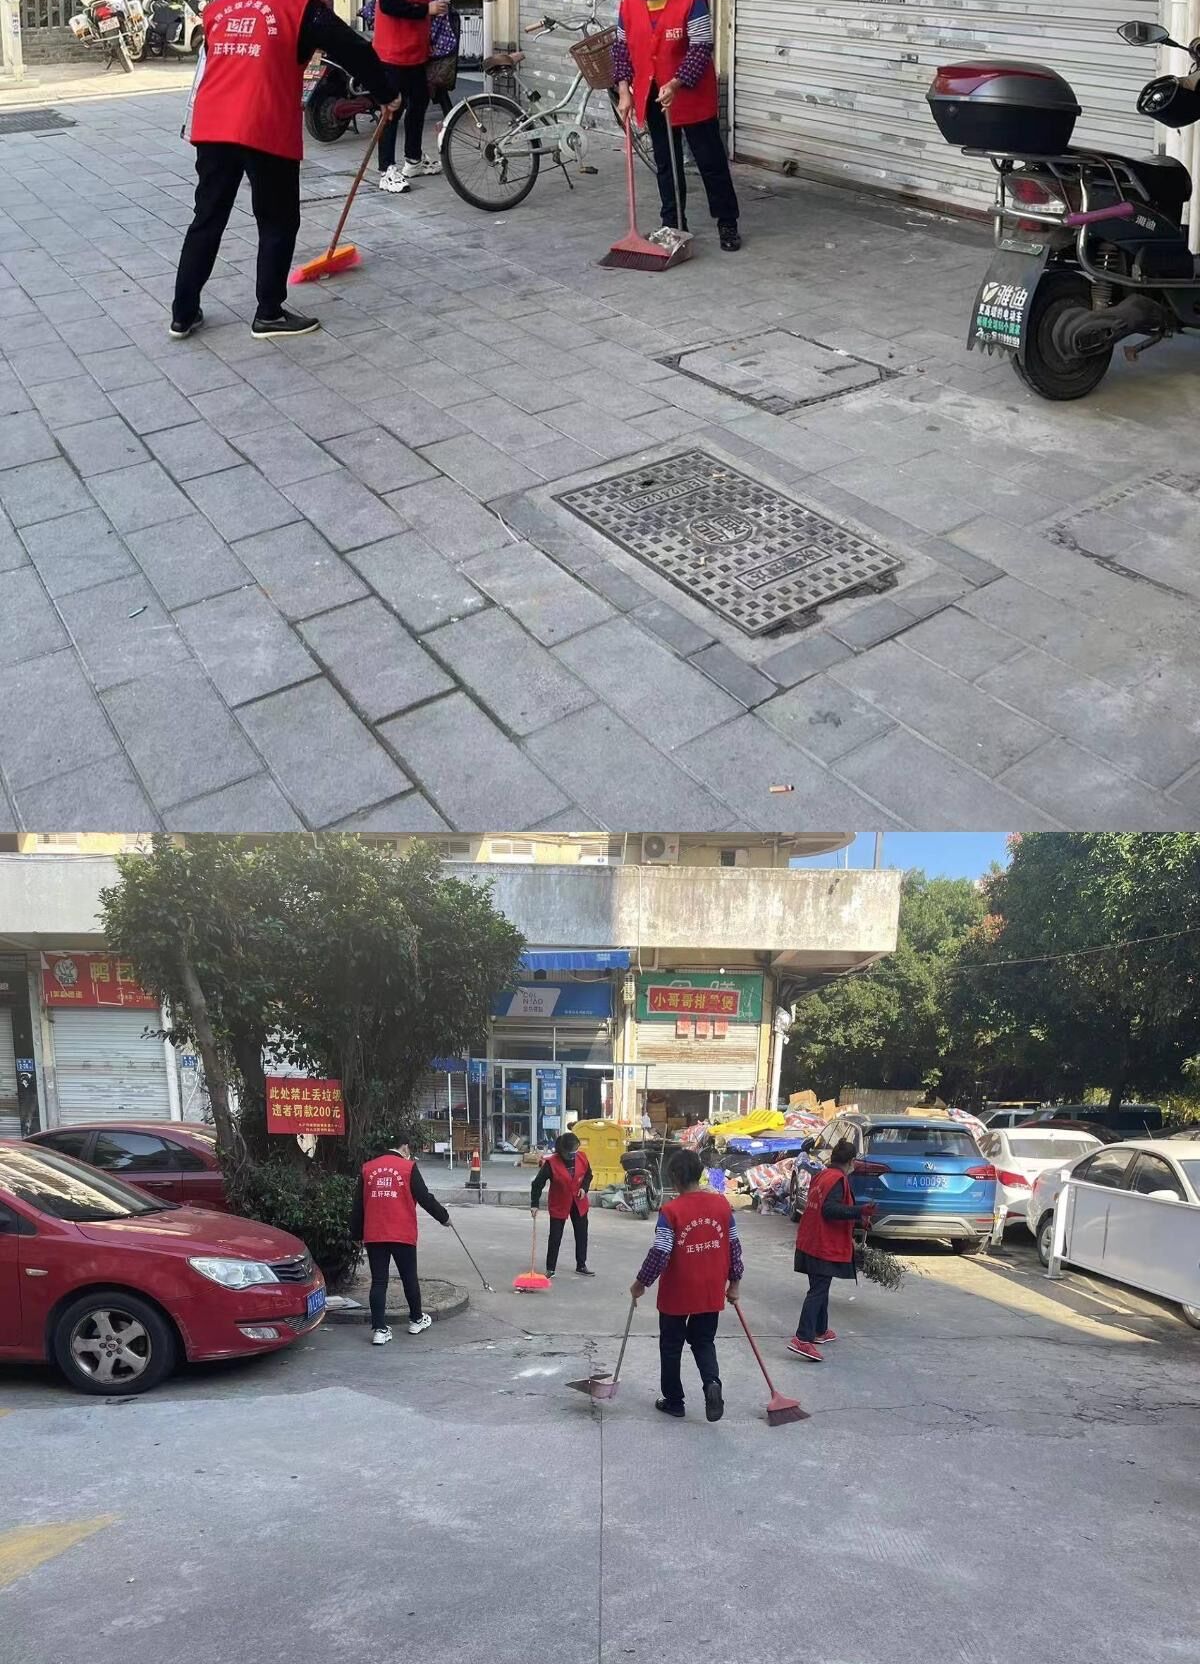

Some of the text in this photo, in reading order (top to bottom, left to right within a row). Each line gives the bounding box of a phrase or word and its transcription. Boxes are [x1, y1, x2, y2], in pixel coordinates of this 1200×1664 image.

[213, 42, 262, 57] 正轩环境
[271, 1103, 341, 1119] 违者罚款200元
